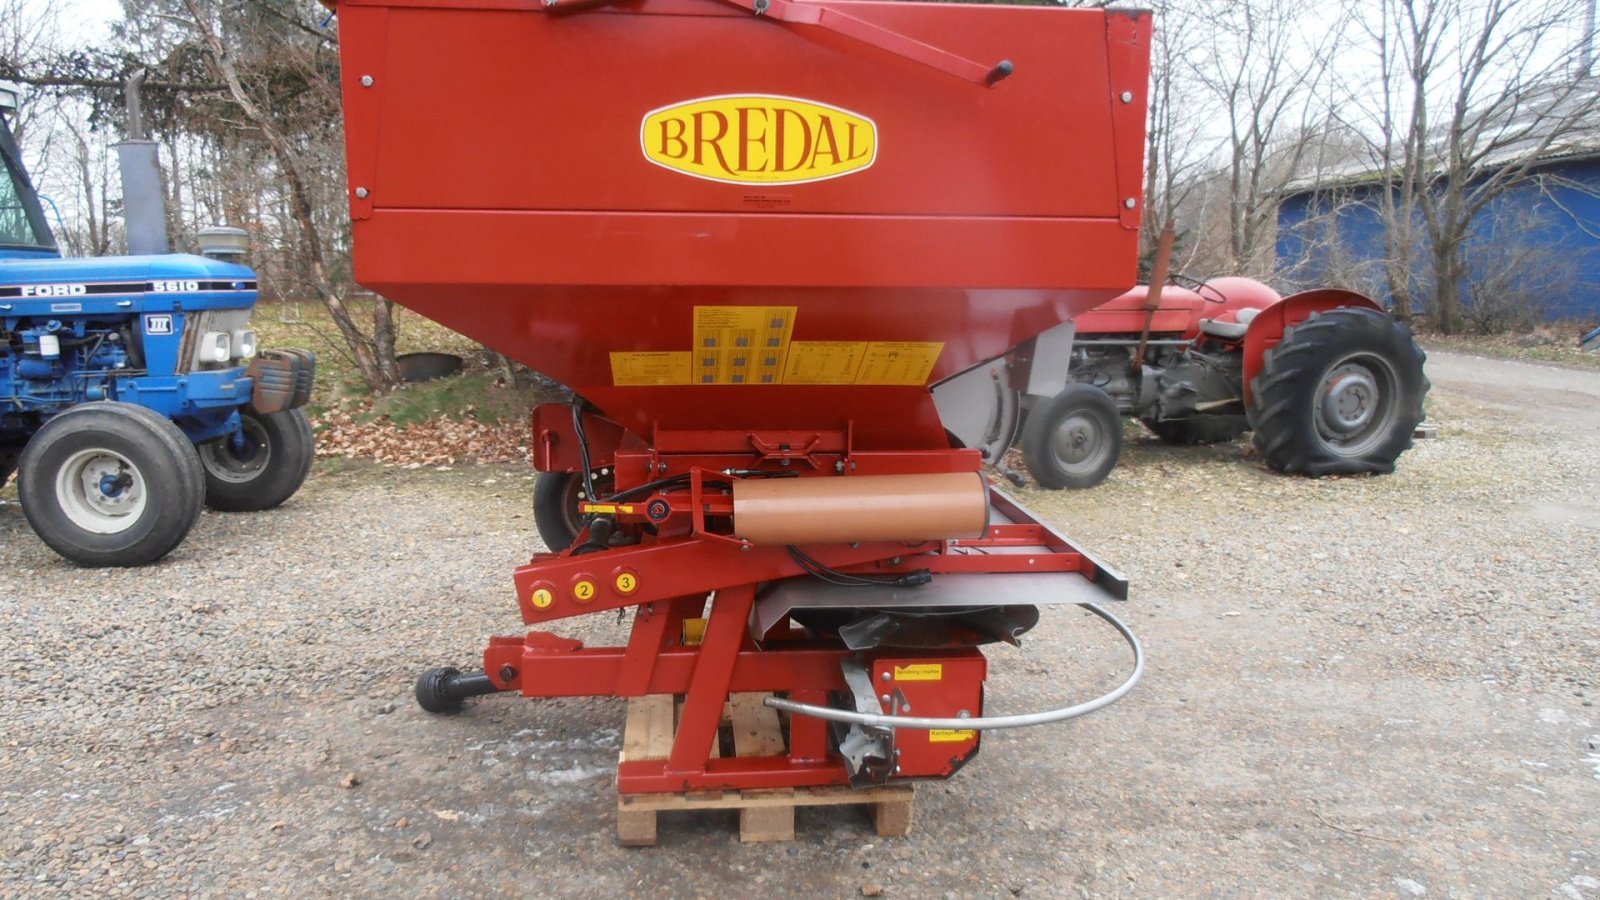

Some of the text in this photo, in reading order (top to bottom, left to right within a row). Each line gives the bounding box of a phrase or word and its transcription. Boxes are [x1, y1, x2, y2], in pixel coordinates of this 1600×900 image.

[658, 107, 869, 176] BREDAL
[21, 281, 200, 298] FORD 5610
[622, 577, 630, 588] 3
[580, 584, 589, 597] 2
[538, 594, 545, 604] 1
